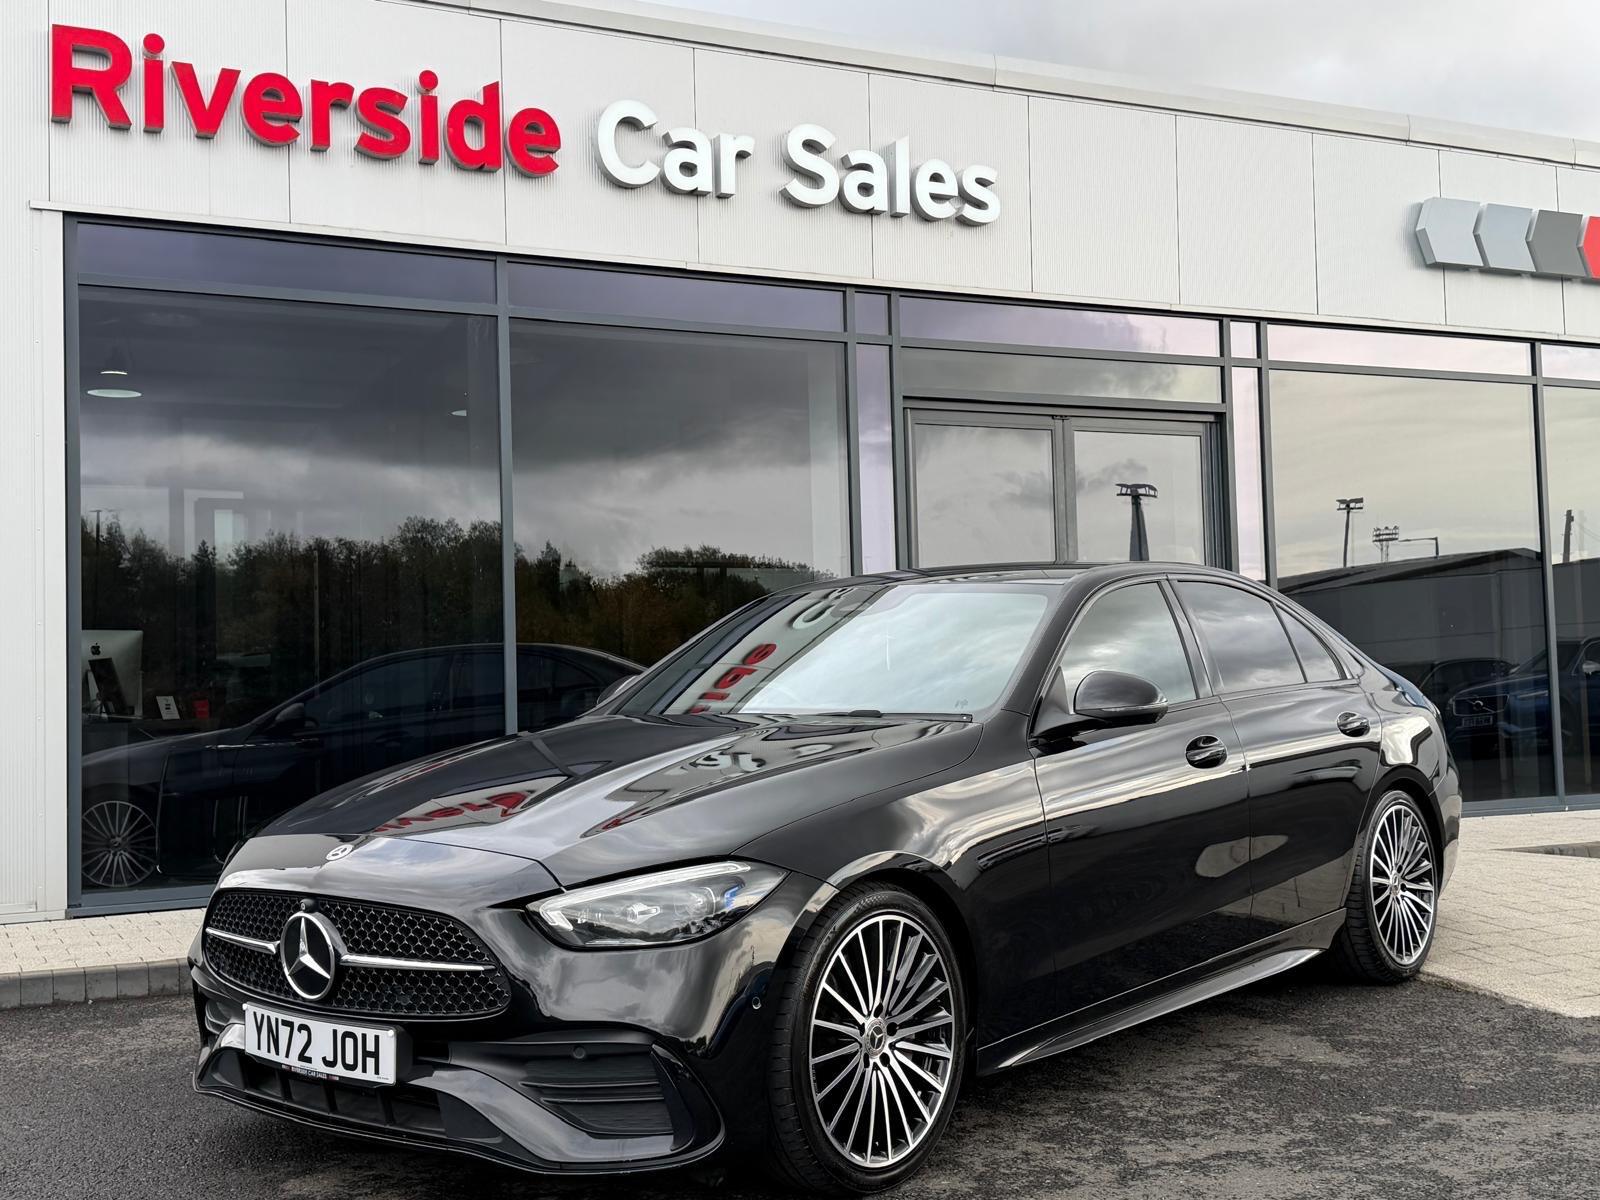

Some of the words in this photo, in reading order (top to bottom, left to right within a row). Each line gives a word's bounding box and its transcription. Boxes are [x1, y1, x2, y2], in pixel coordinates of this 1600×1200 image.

[51, 24, 561, 177] Riverside
[594, 100, 755, 198] Car
[779, 123, 1001, 226] Sales
[253, 1011, 312, 1064] YN72
[322, 1029, 380, 1076] JOH
